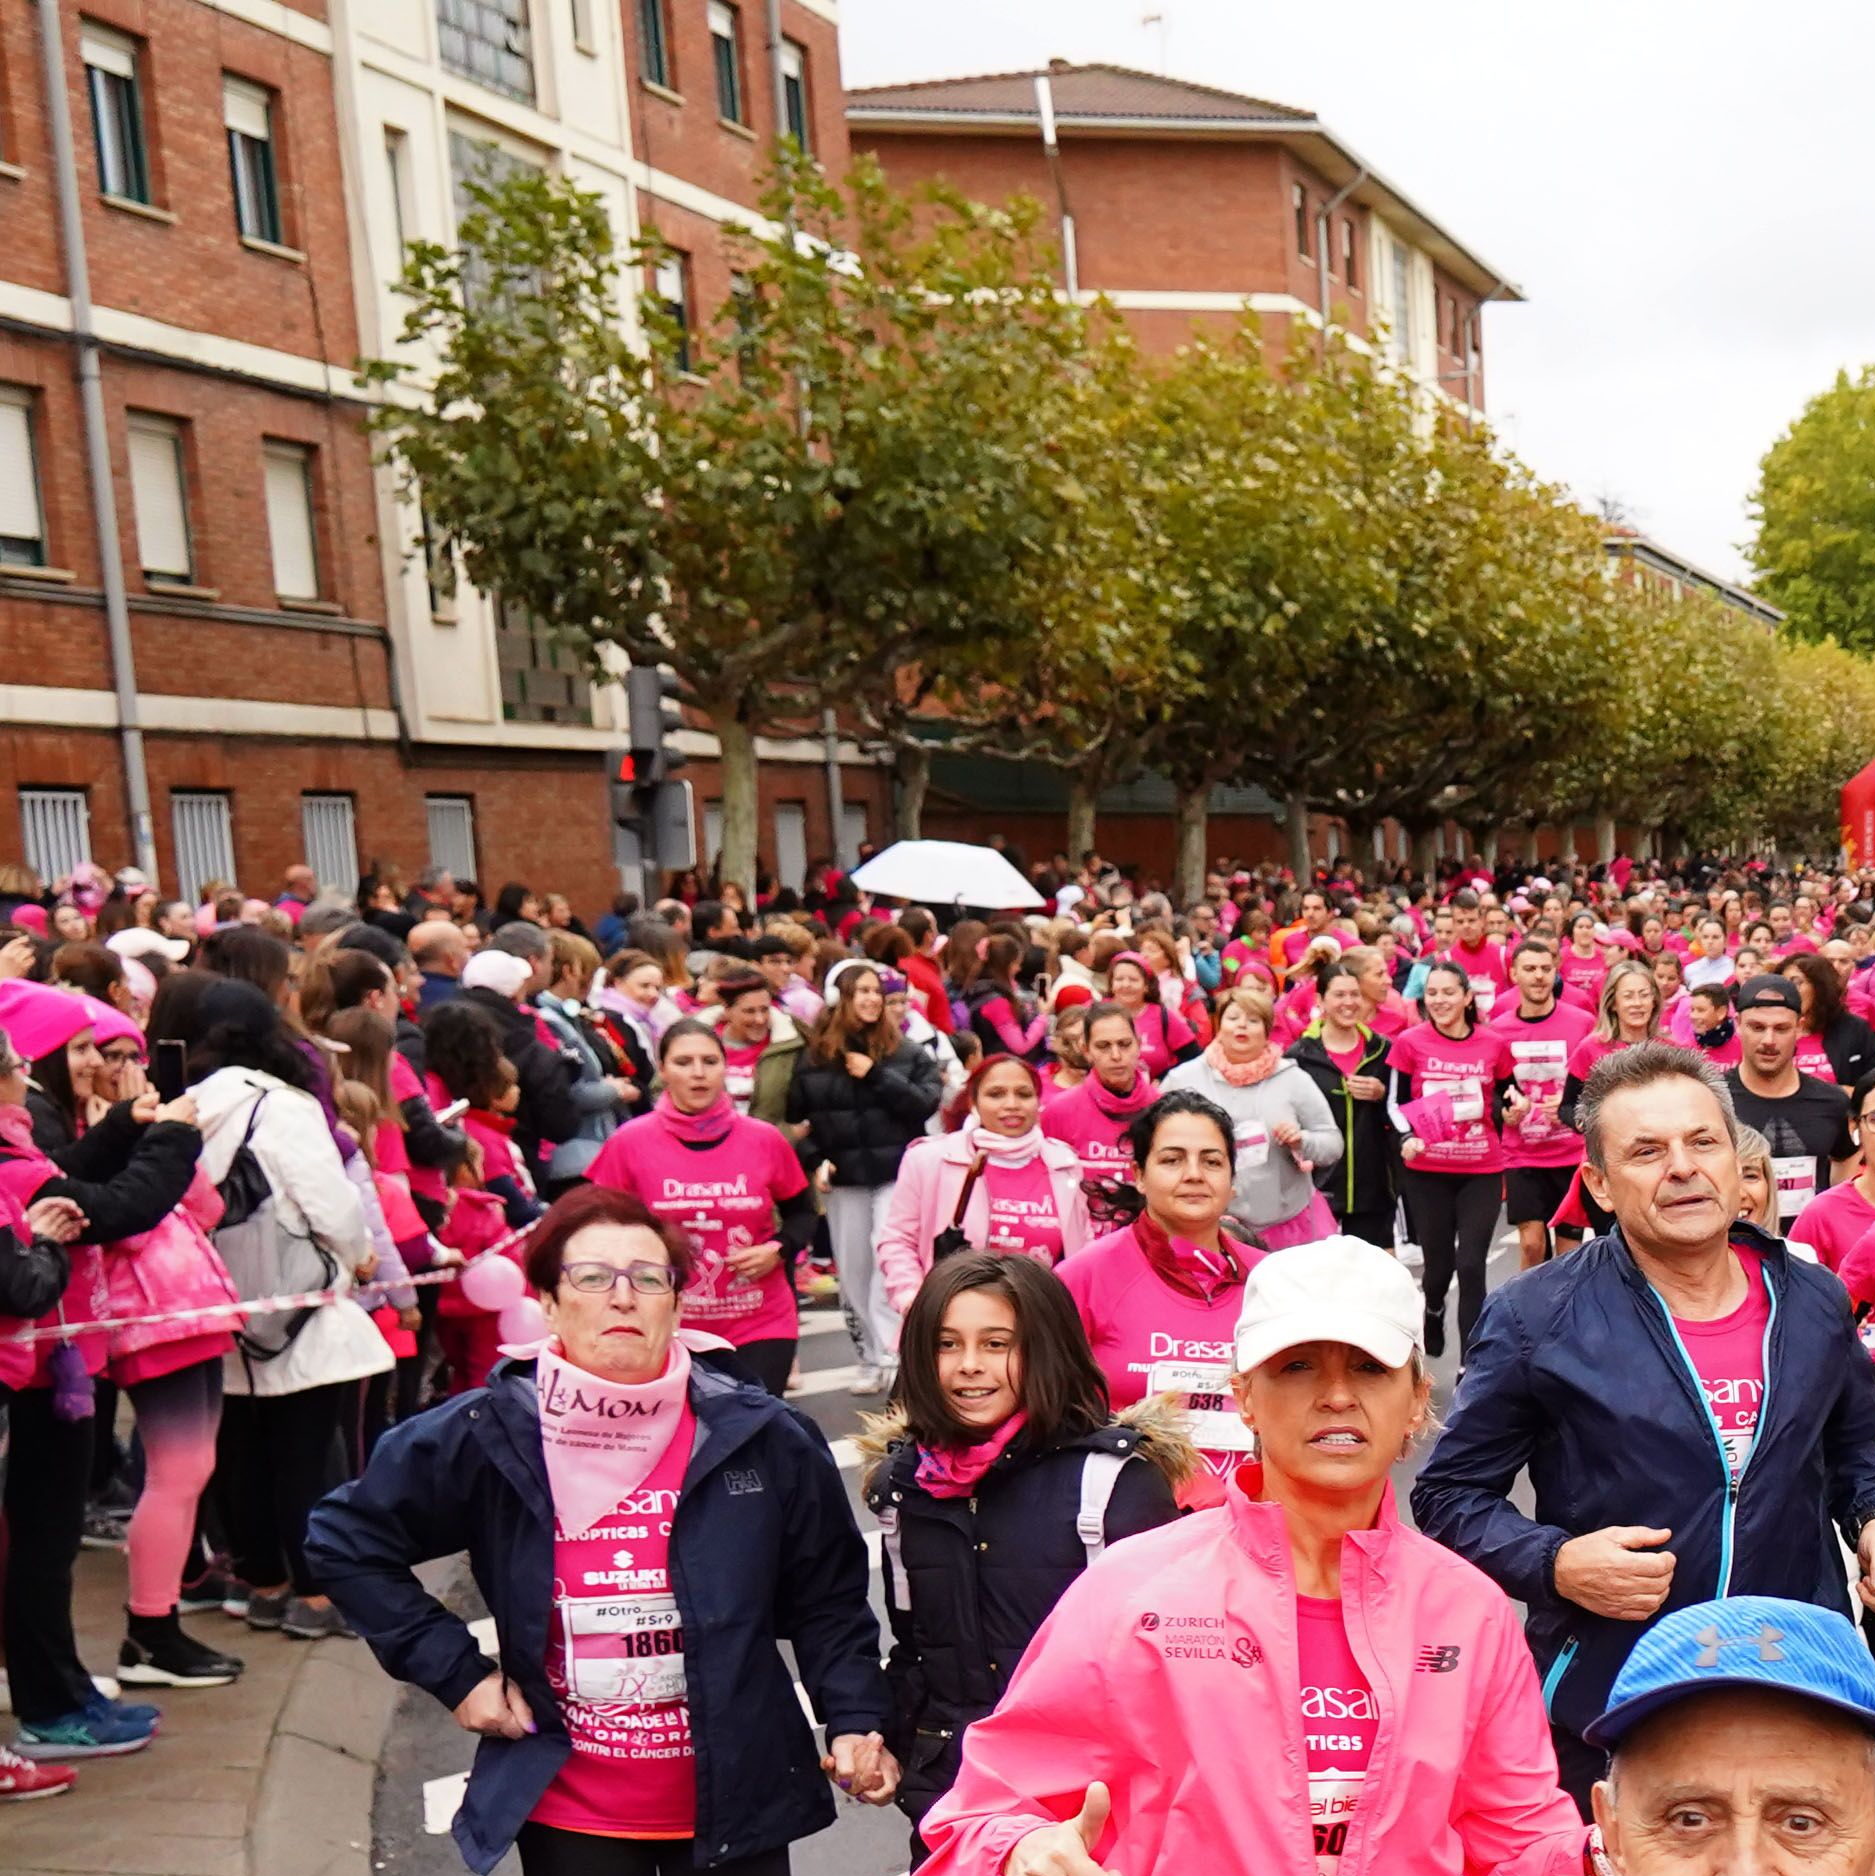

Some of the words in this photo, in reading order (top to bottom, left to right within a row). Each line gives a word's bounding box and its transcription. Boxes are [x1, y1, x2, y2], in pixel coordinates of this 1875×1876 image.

[583, 1568, 667, 1586] SUZUKI
[1165, 1617, 1225, 1629] ZURICH
[1165, 1633, 1225, 1646] MARATÓN
[1165, 1647, 1226, 1659] SEVILLA
